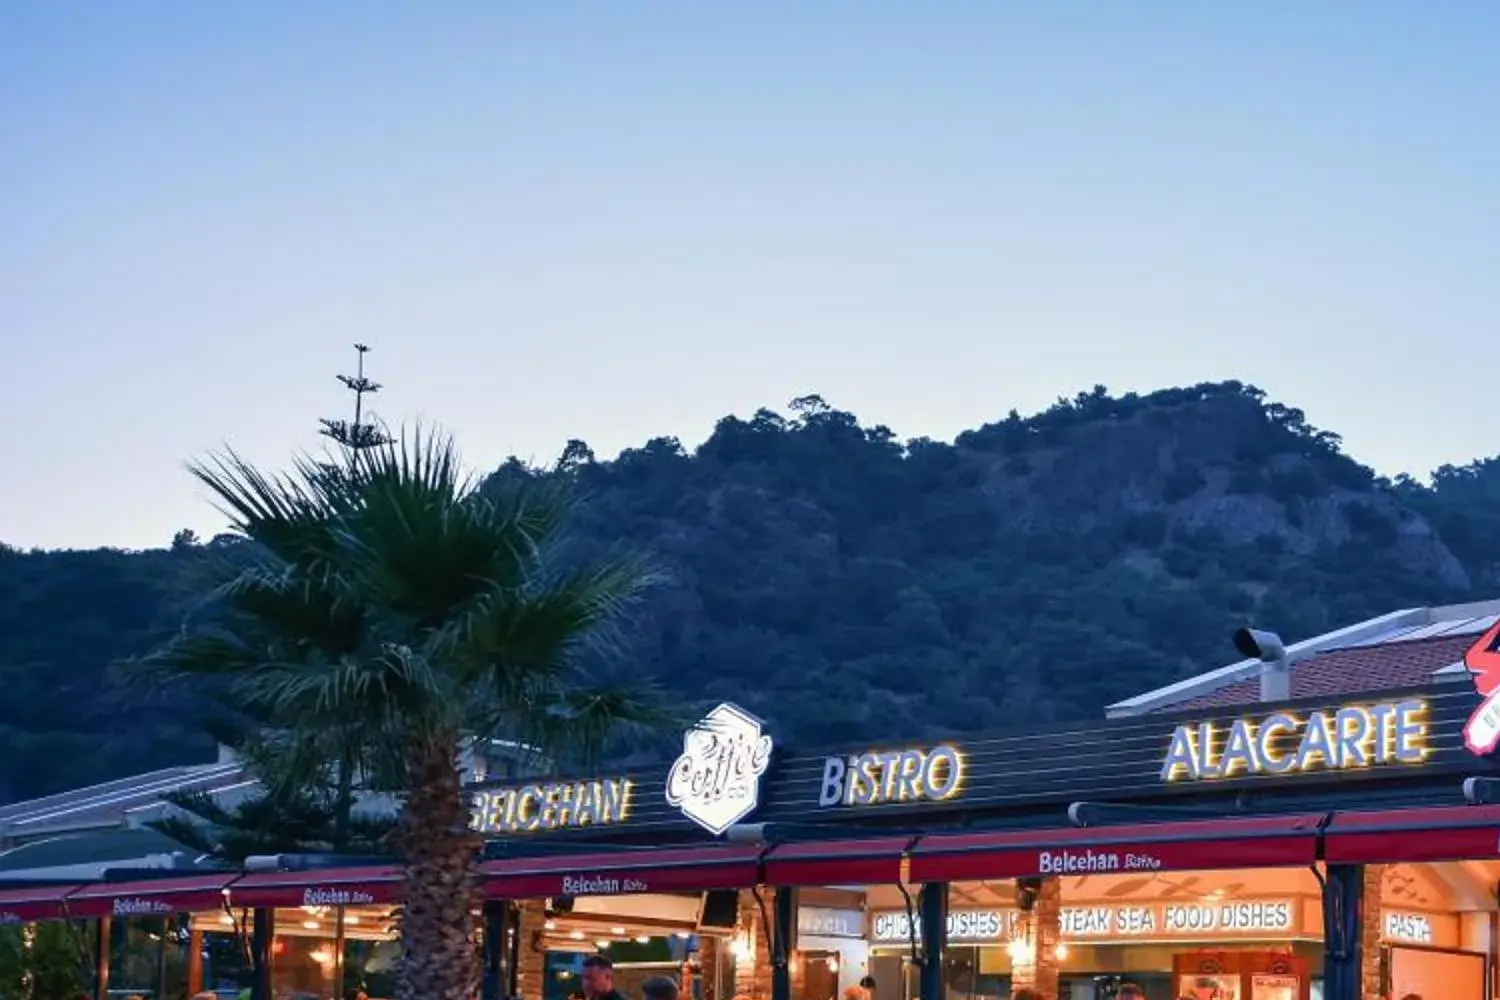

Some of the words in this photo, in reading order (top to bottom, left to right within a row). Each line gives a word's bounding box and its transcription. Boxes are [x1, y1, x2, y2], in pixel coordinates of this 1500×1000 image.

[1159, 698, 1429, 782] ALACARTE
[1039, 849, 1118, 873] Belcehan
[946, 910, 1001, 937] DISHES
[1115, 907, 1154, 931] SEA
[1162, 904, 1214, 929] FOOD
[1219, 902, 1290, 927] DISHES
